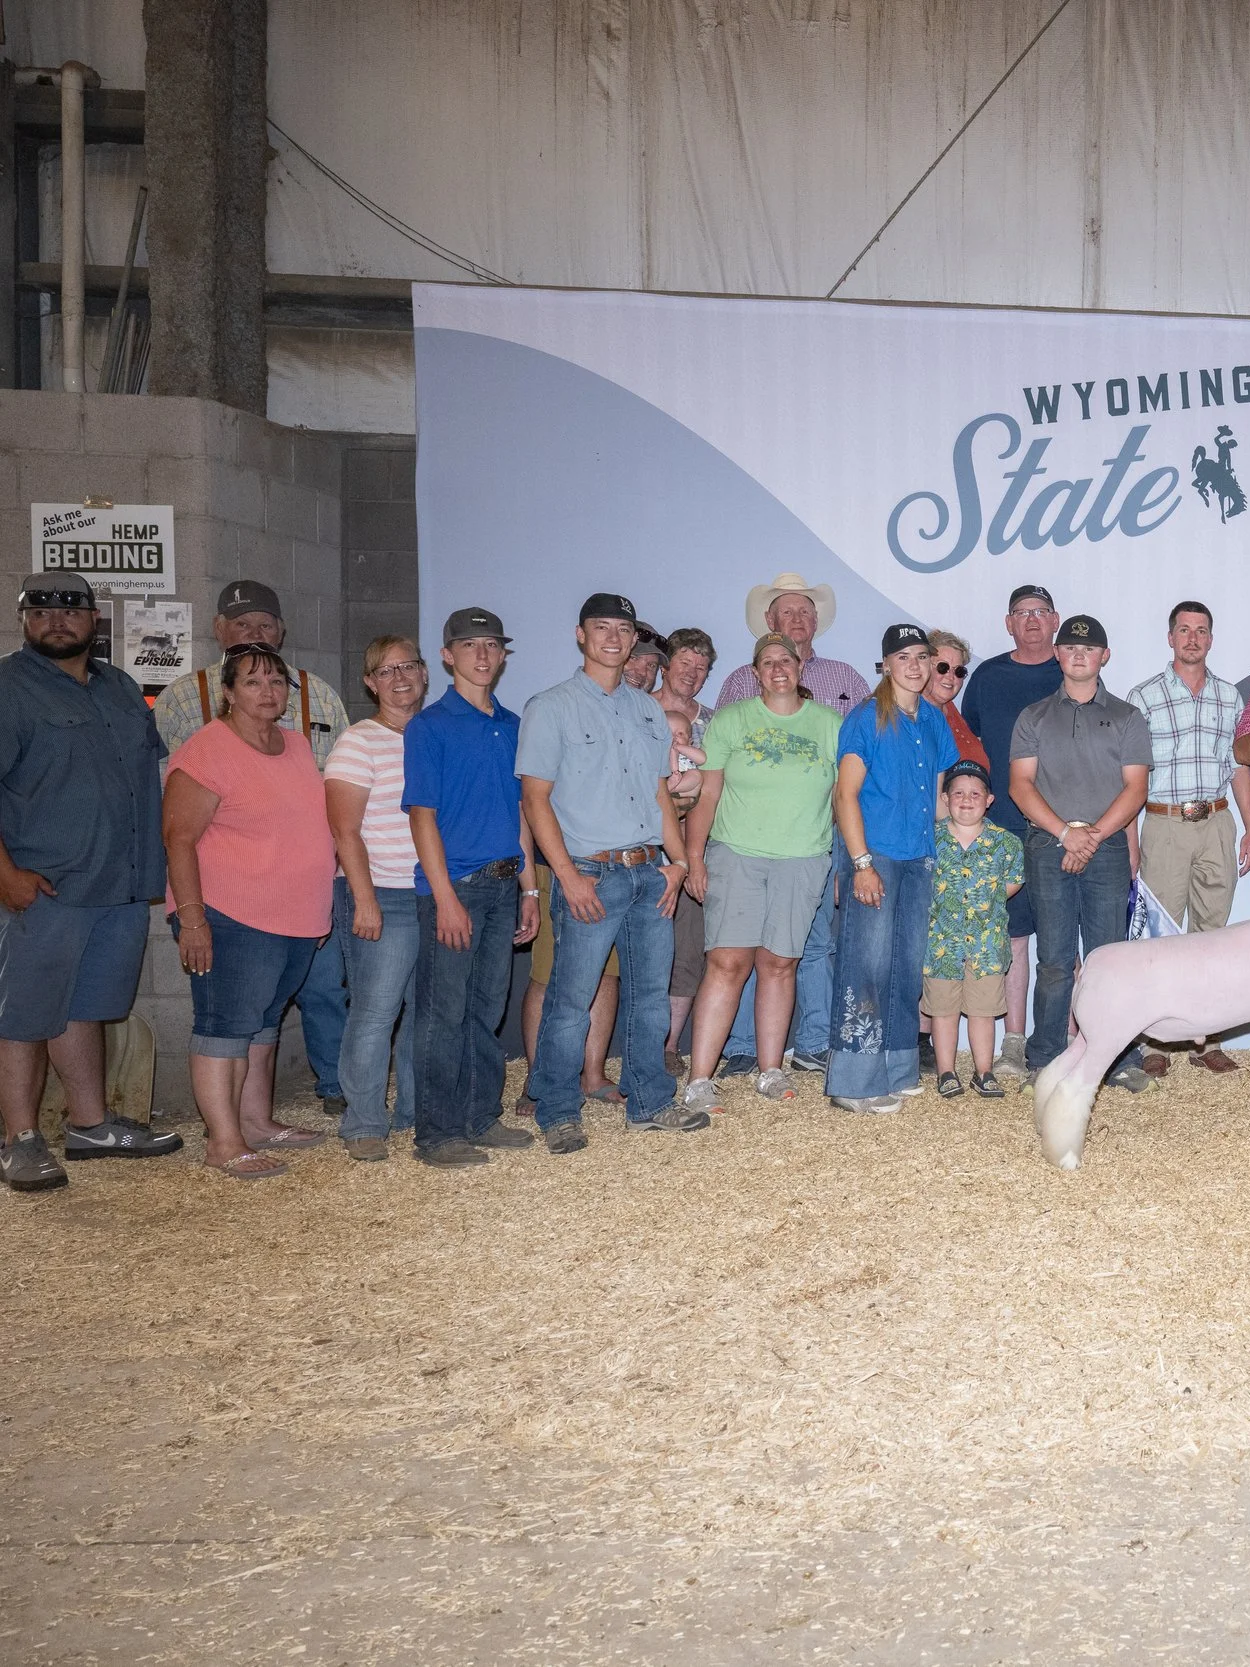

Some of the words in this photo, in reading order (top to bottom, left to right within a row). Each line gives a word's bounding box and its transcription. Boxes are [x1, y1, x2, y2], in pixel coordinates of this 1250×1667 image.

[886, 413, 1183, 574] State
[43, 513, 63, 527] Ask
[64, 510, 82, 521] me
[43, 521, 76, 538] about
[77, 517, 96, 528] our
[112, 524, 159, 540] HEMP
[44, 543, 158, 569] BEDDING
[90, 579, 165, 590] wyominghemp.us
[133, 656, 184, 667] EPISODE
